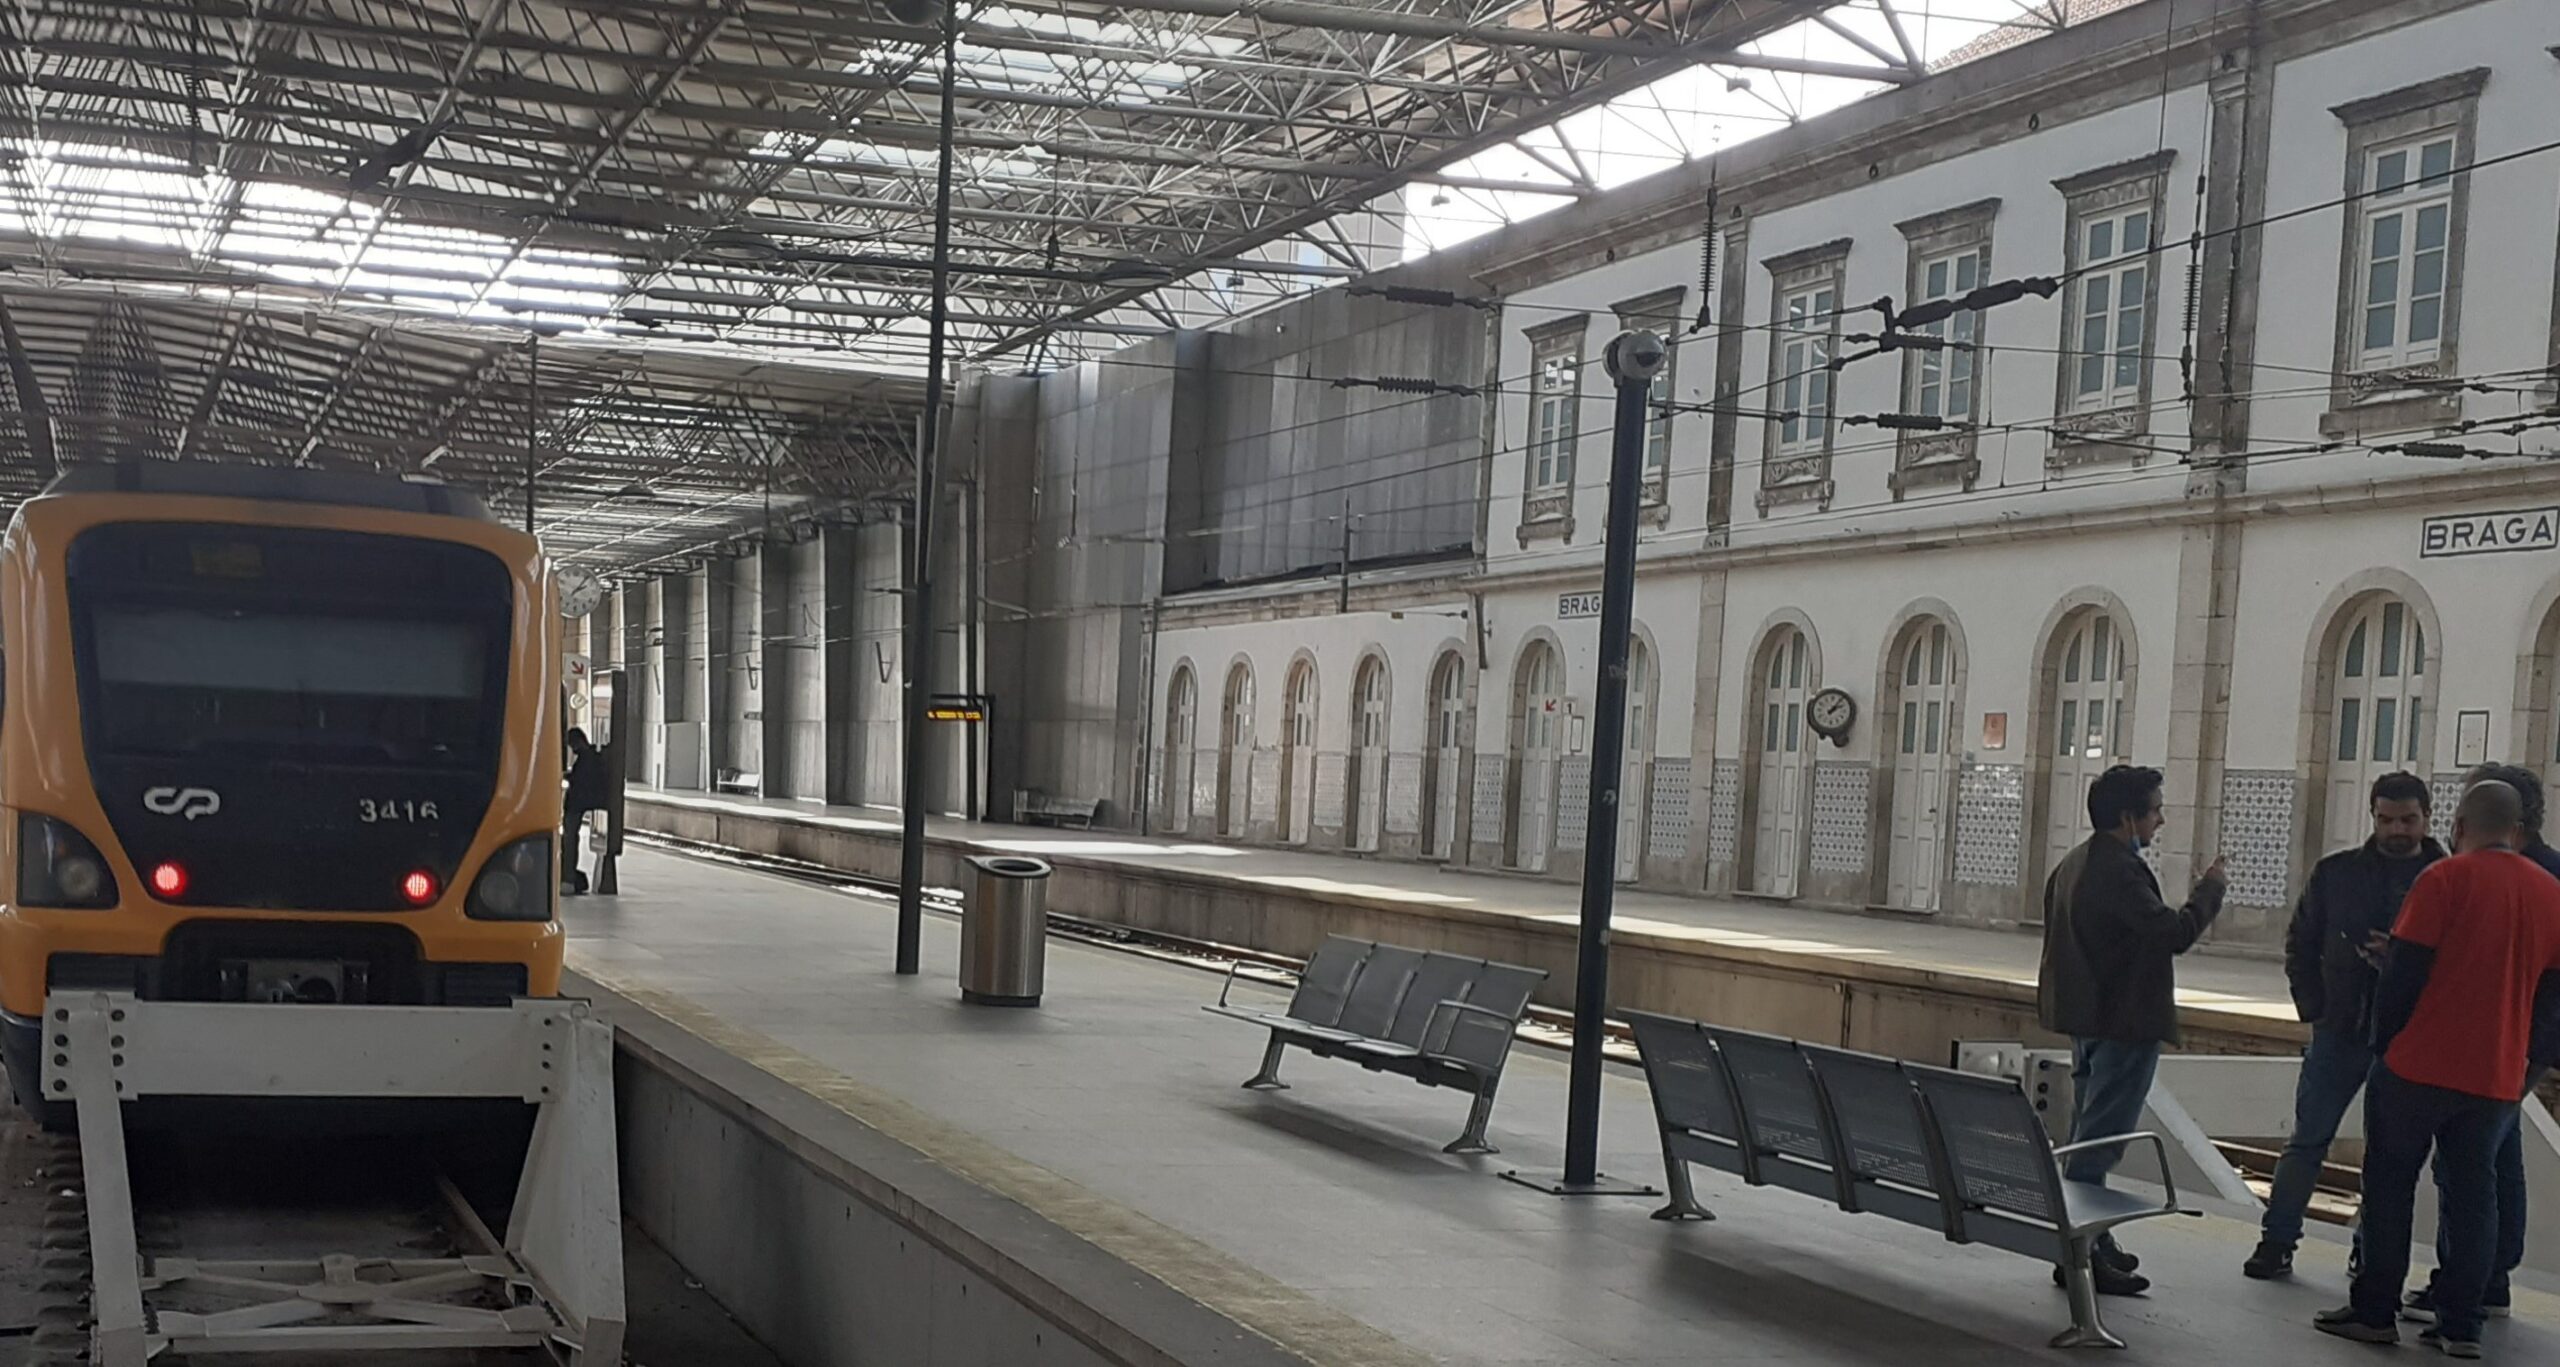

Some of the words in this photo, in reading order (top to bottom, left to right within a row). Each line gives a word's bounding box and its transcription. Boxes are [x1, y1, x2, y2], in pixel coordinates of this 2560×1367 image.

[2426, 515, 2553, 550] BRAGA
[1560, 596, 1600, 615] BRAG
[360, 798, 439, 823] 3416
